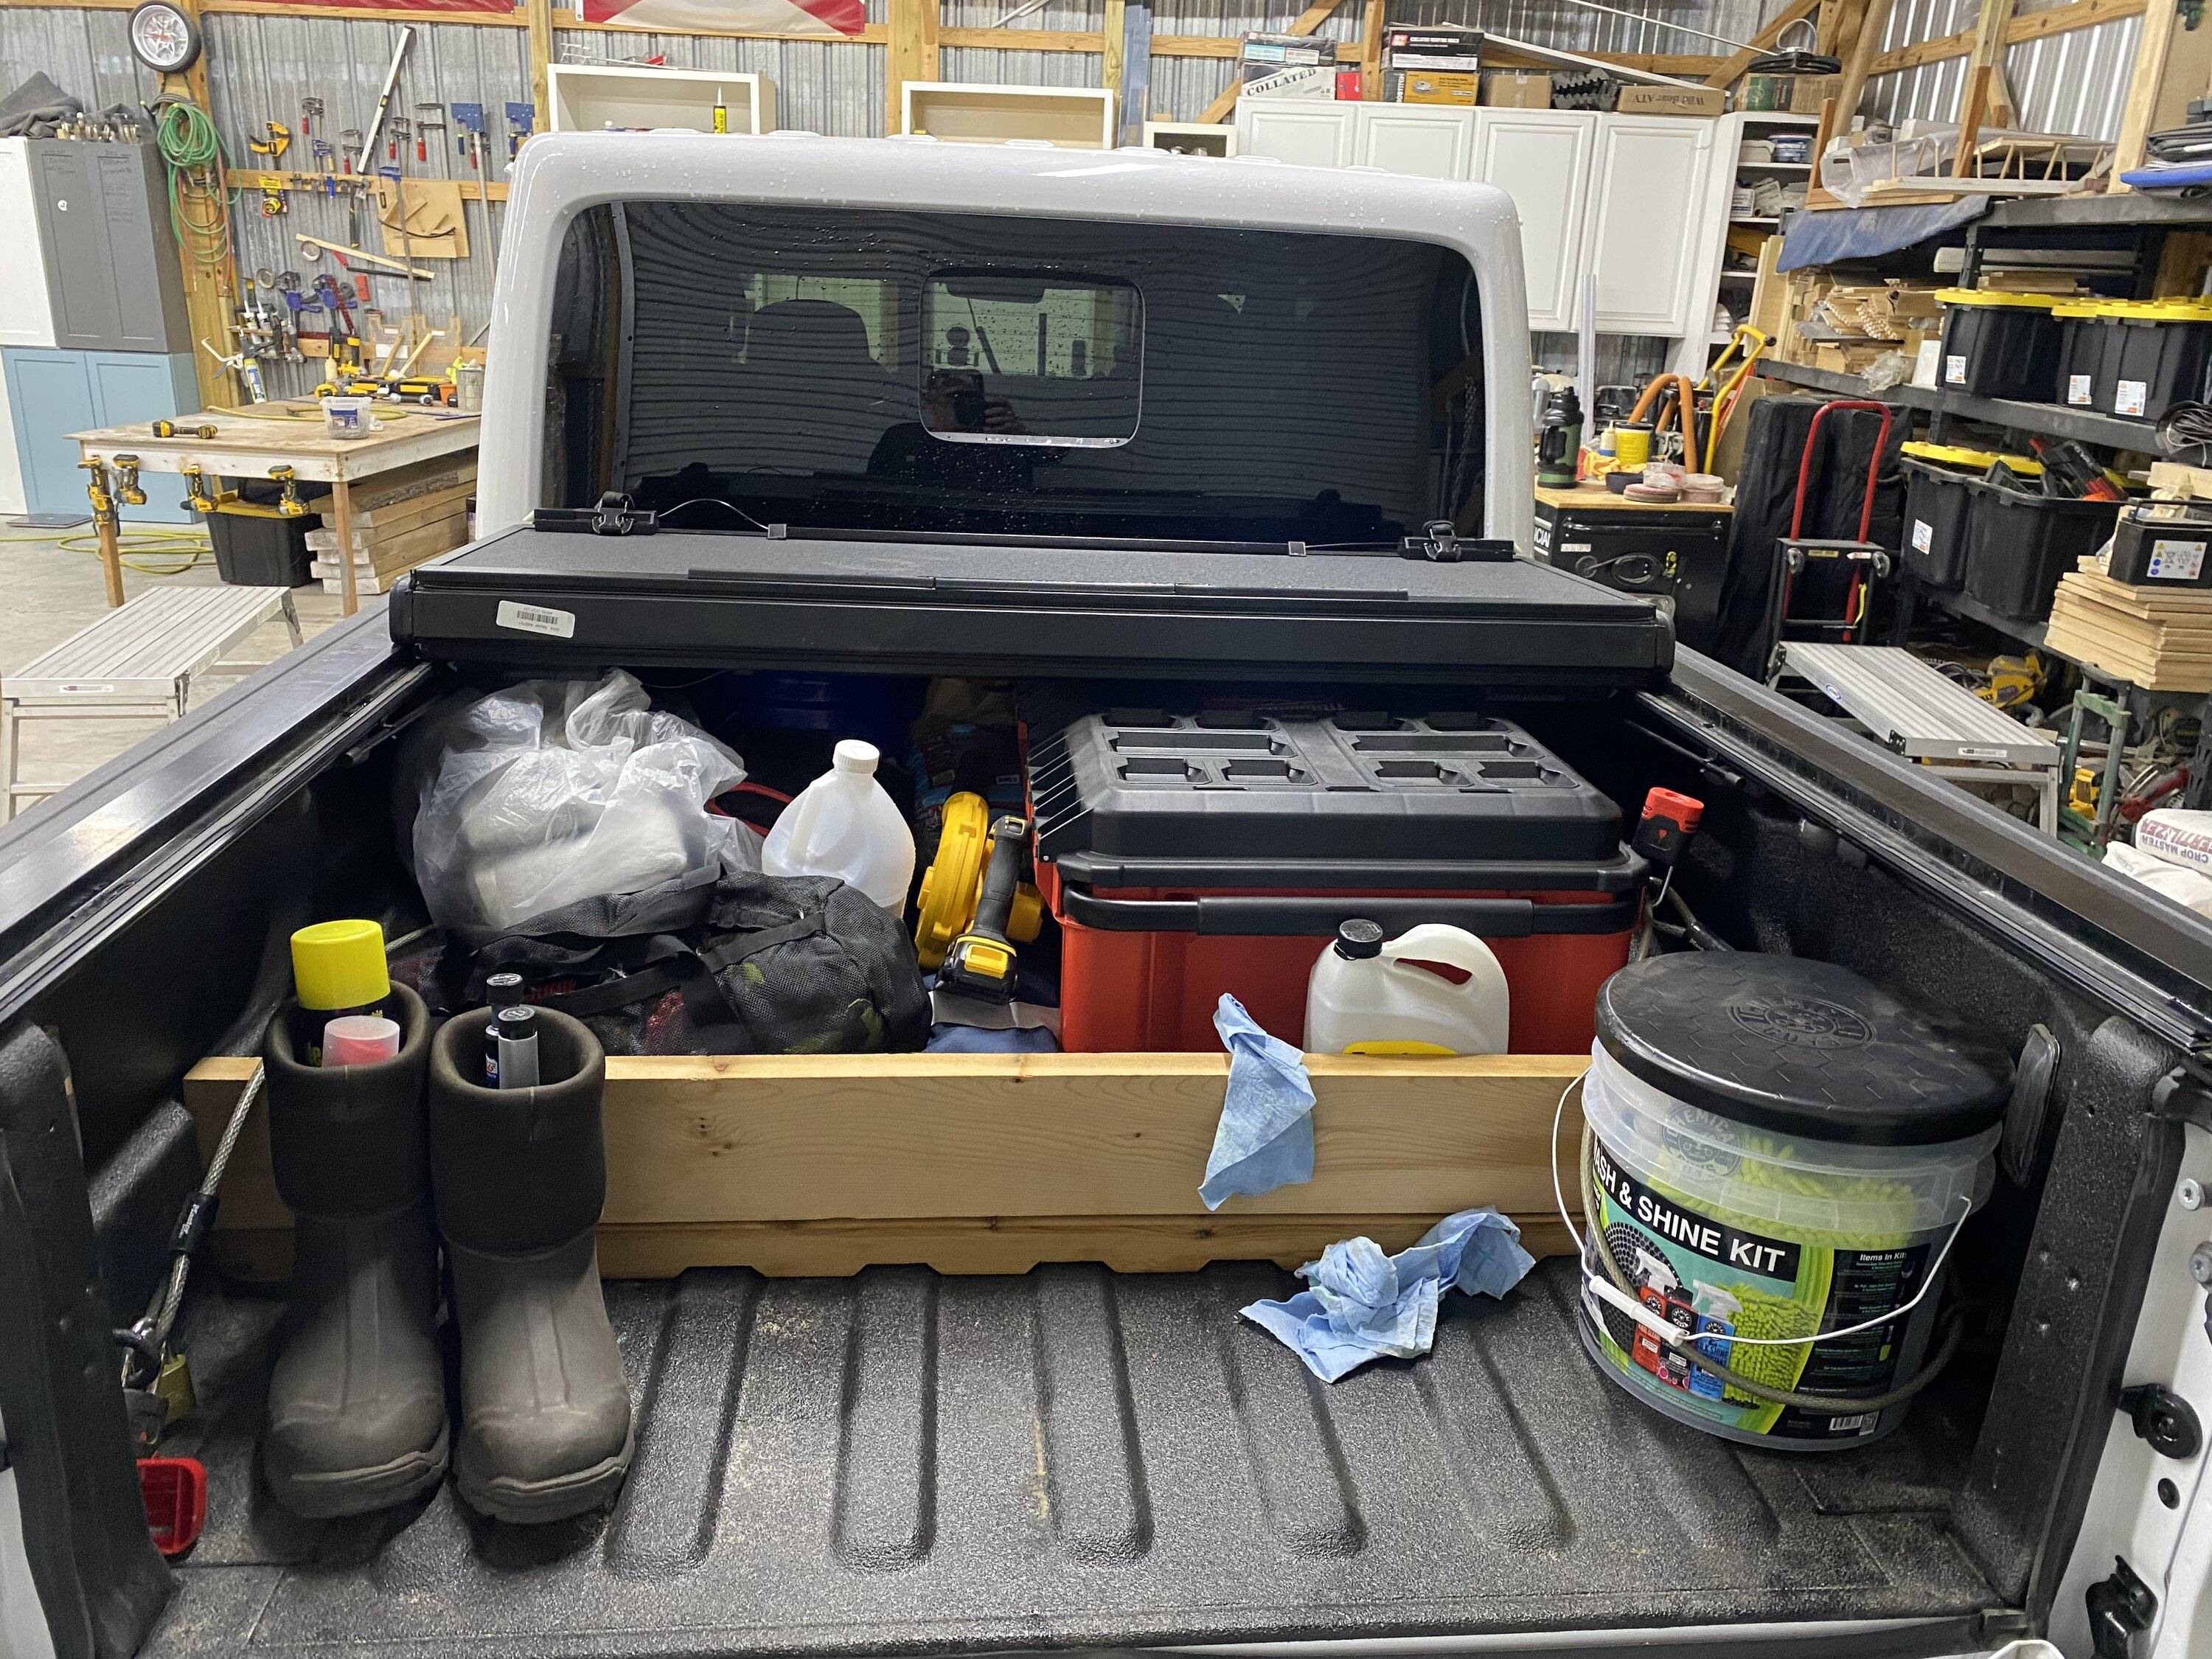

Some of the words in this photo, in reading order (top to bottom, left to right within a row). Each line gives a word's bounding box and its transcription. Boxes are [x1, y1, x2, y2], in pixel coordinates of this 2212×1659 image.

[1246, 68, 1316, 97] COLLATED
[1632, 94, 1654, 102] ATV
[2142, 835, 2178, 854] MASTER
[2181, 849, 2209, 863] CROP
[1619, 1181, 1632, 1210] &
[1638, 1195, 1722, 1256] SHINE
[1729, 1239, 1786, 1273] KIT
[1860, 1253, 1882, 1262] Items
